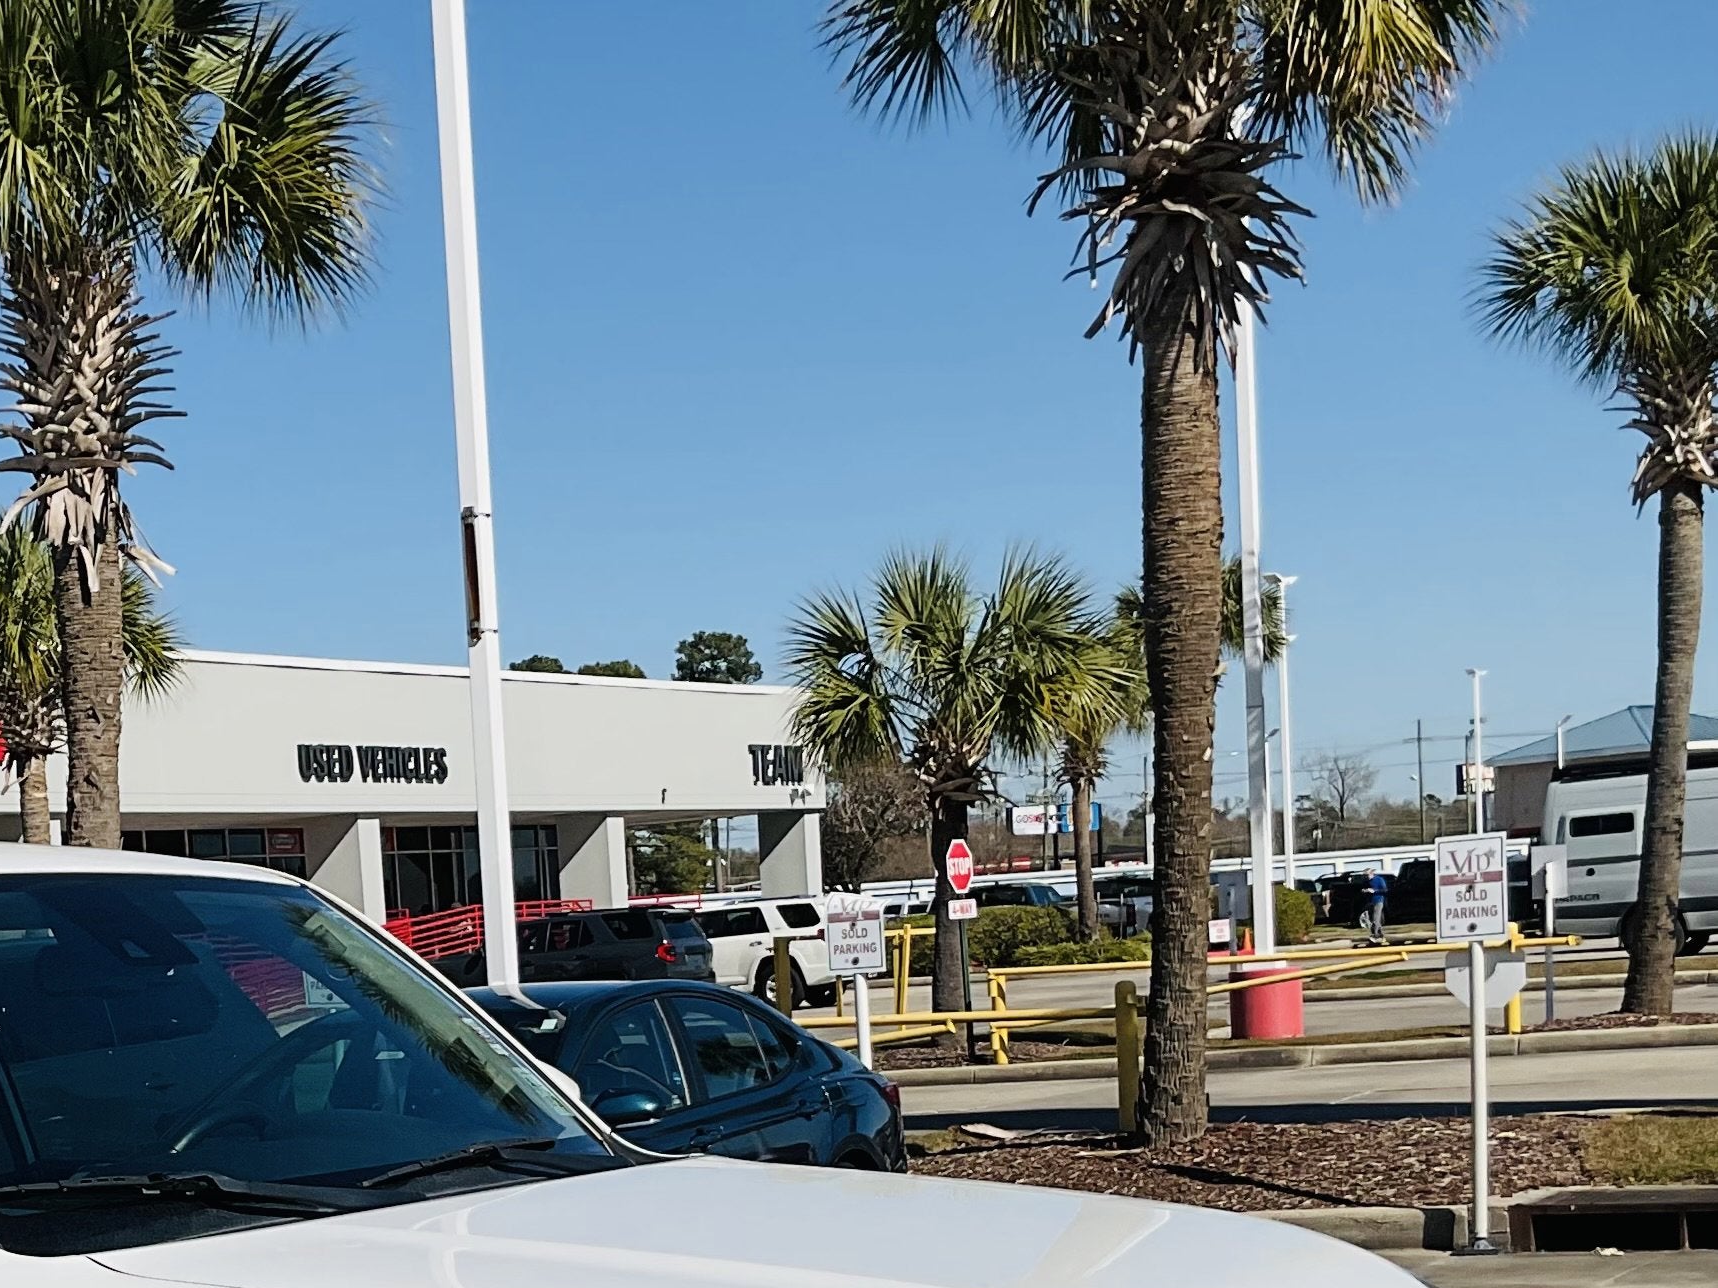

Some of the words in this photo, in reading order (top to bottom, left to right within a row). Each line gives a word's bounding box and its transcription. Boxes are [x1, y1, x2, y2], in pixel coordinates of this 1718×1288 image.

[297, 744, 354, 783] USED
[356, 745, 448, 784] VEHICLES
[948, 857, 970, 876] STOP
[1456, 889, 1487, 902] SOLD
[1445, 905, 1498, 920] PARKING
[842, 928, 868, 939] SOLD
[833, 942, 877, 955] PARKING
